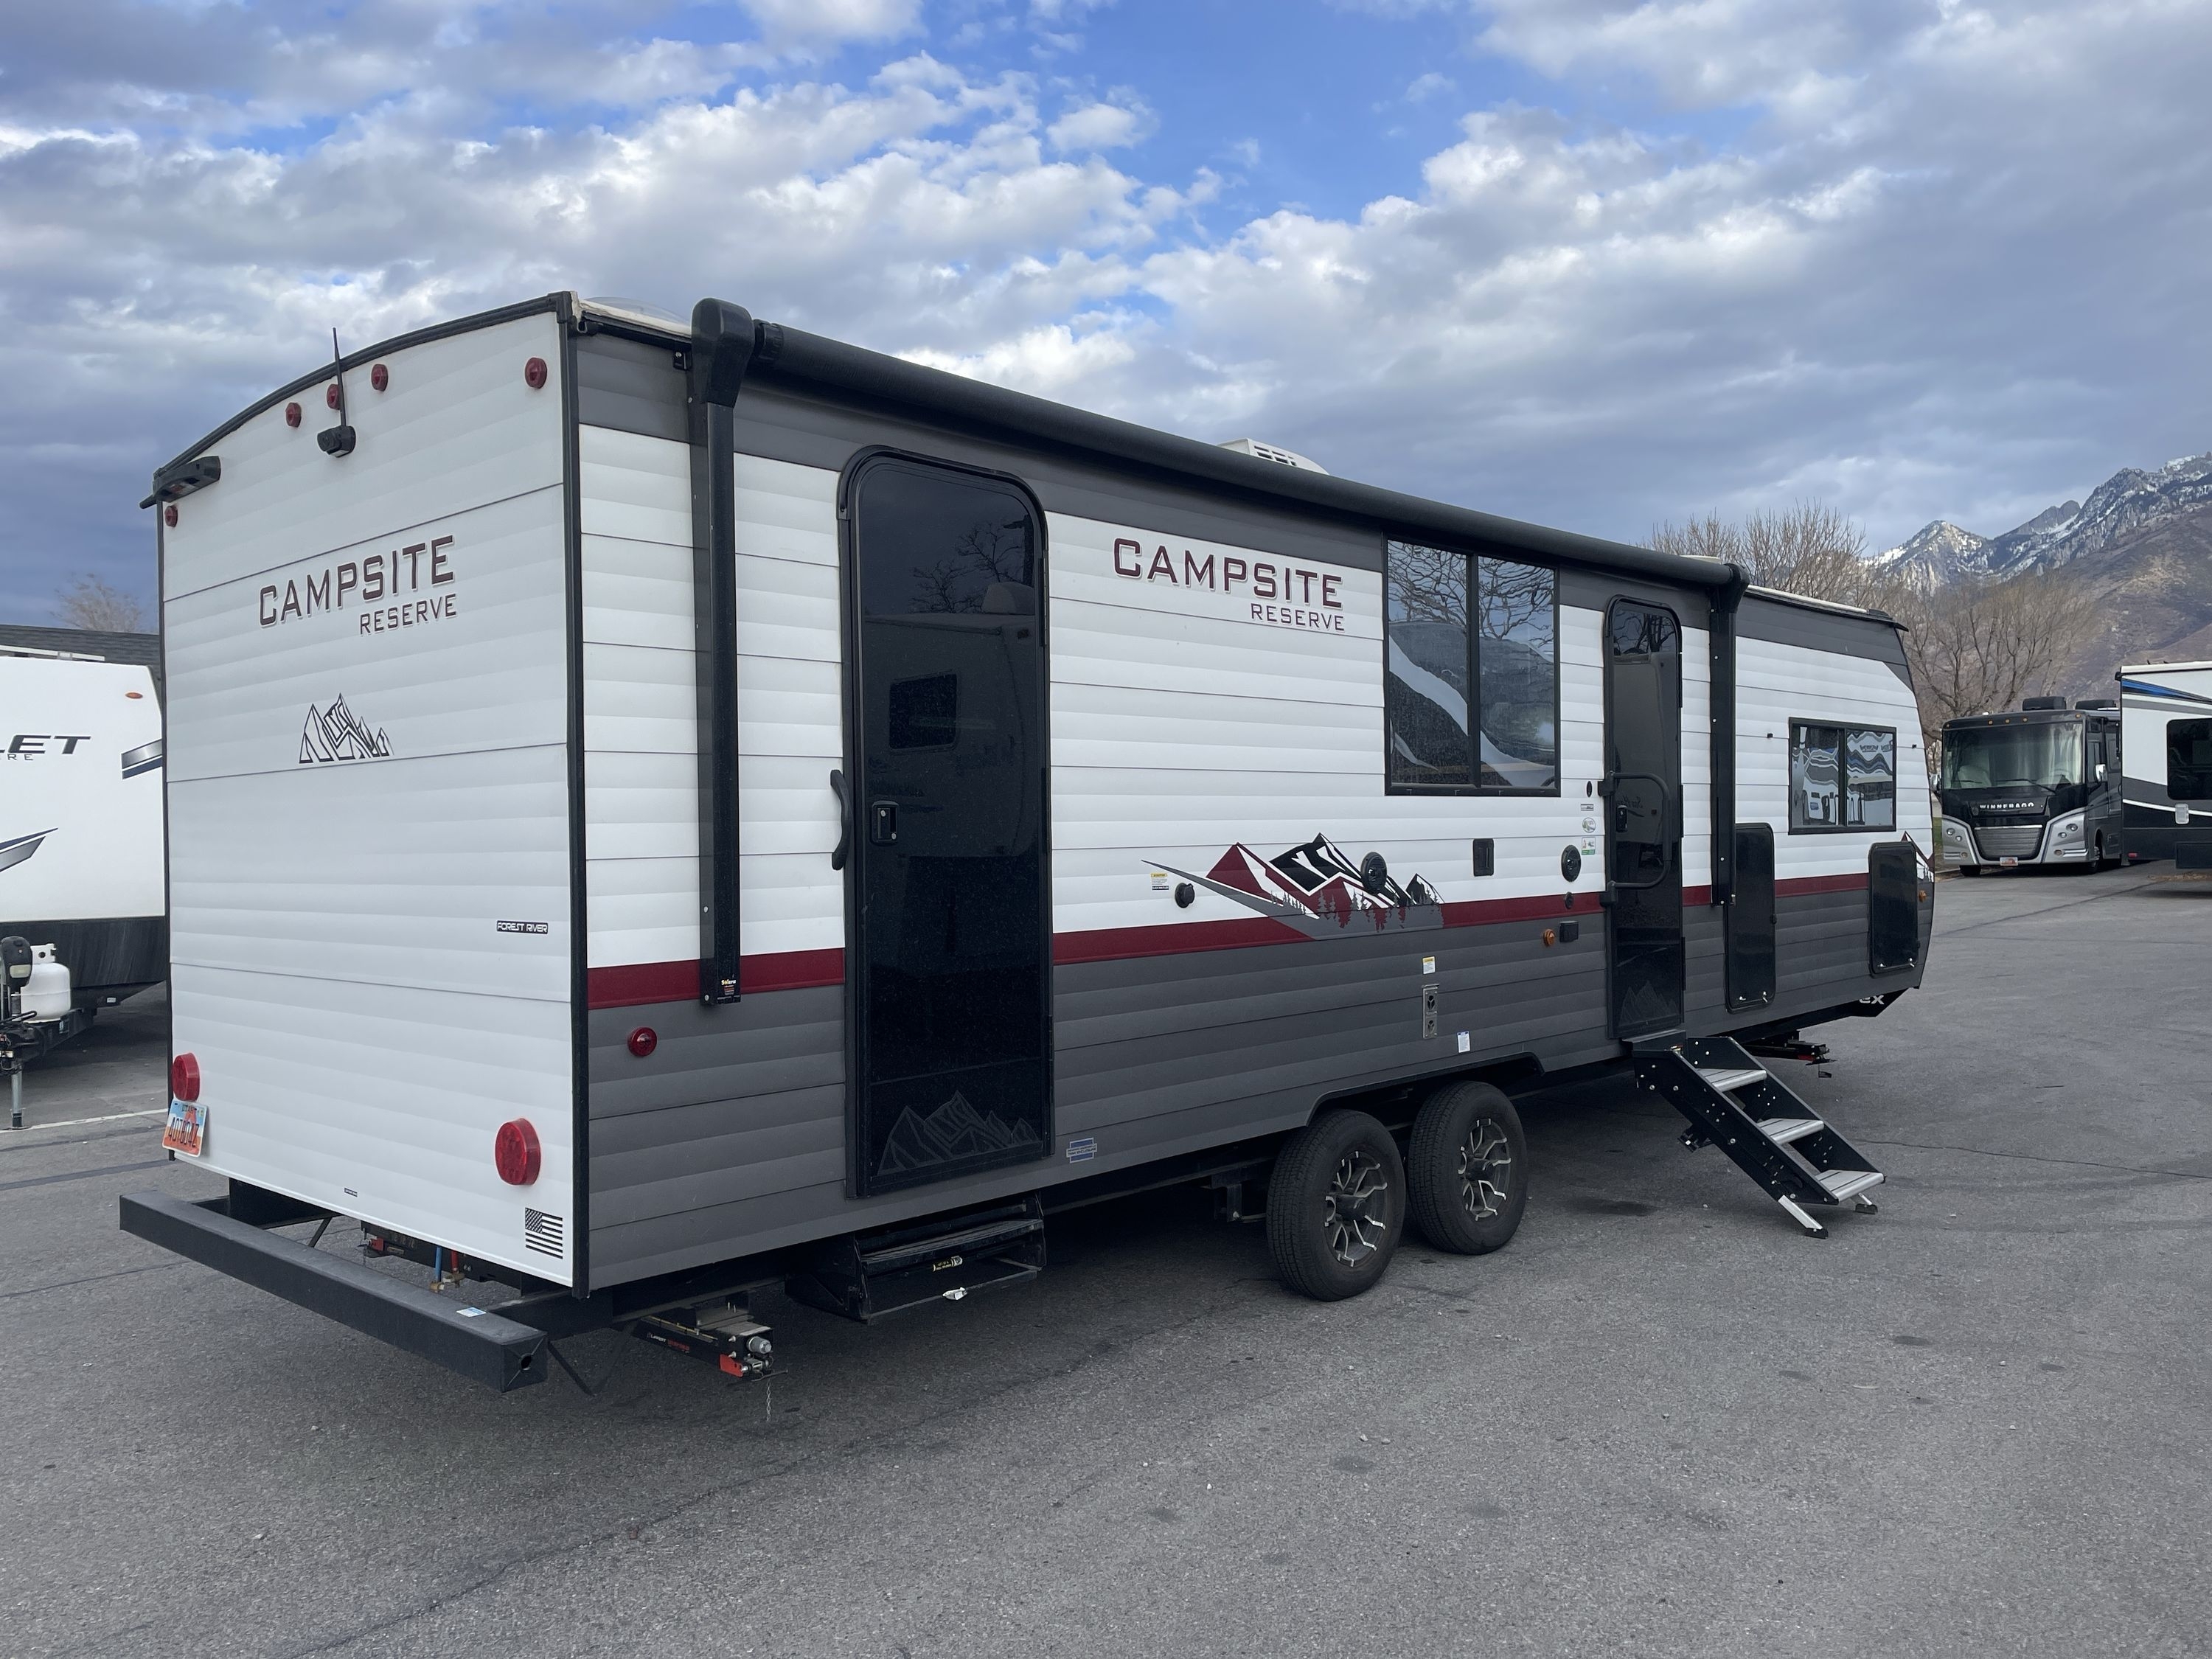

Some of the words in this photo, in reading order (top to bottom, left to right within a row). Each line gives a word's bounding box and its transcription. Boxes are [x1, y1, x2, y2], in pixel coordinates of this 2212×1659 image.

[260, 535, 454, 627] CAMPSITE
[1114, 538, 1342, 608] CAMPSITE
[360, 594, 456, 634] RESERVE
[1251, 603, 1344, 630] RESERVE
[0, 734, 91, 754] ET
[497, 922, 524, 931] FOREST
[526, 924, 547, 932] RIVER
